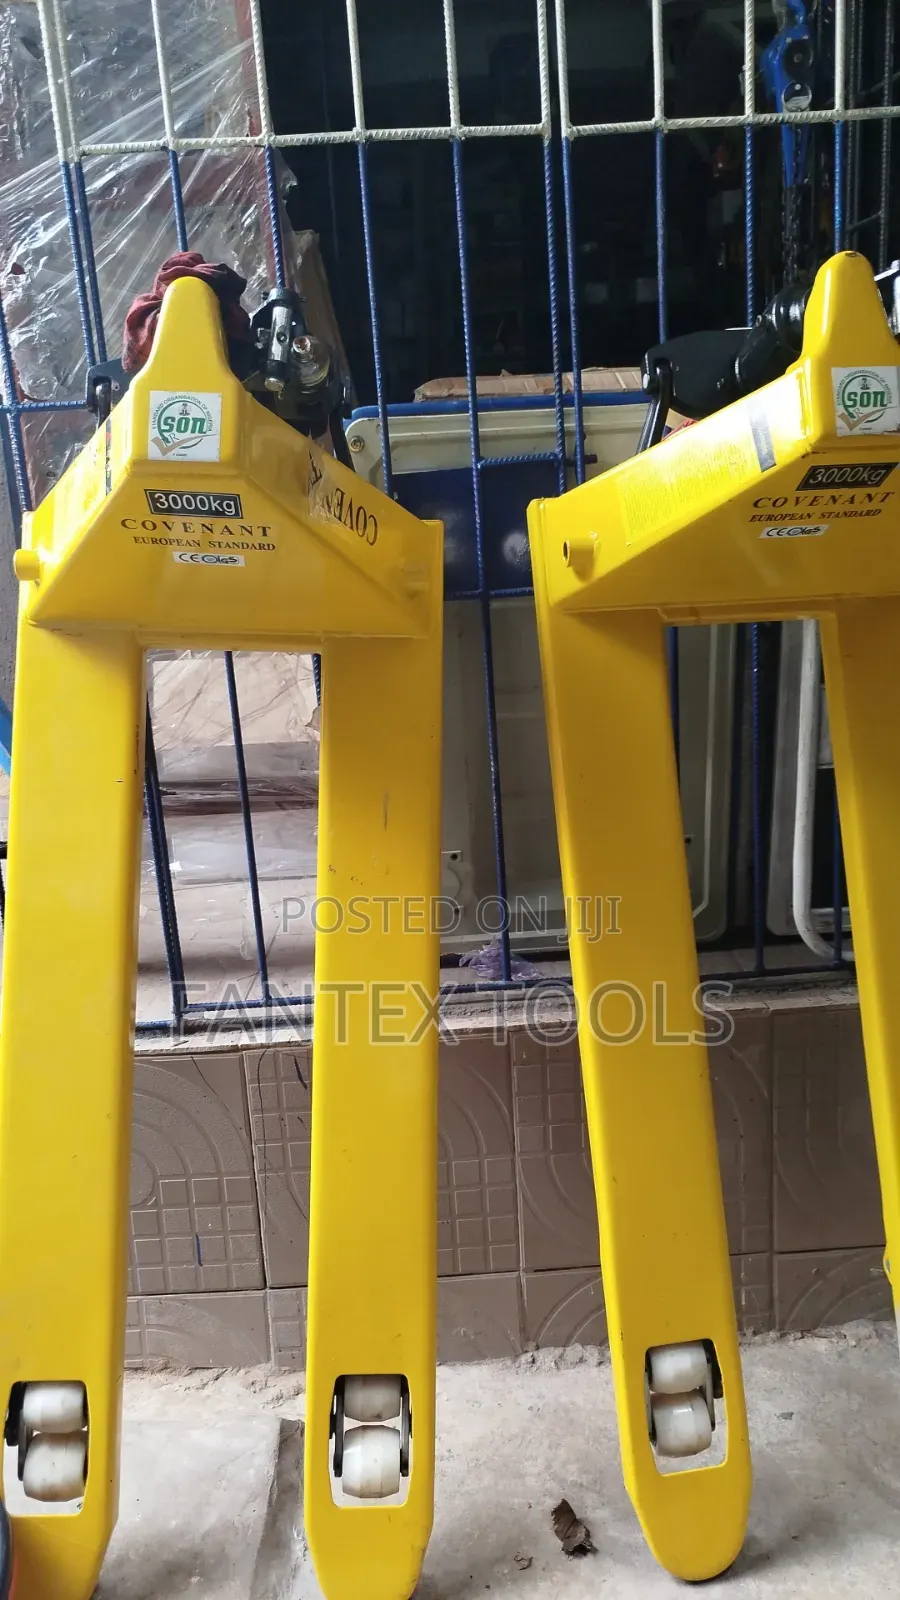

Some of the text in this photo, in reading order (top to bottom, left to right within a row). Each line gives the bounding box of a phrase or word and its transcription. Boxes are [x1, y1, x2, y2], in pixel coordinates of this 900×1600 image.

[809, 466, 888, 484] 3000kg
[154, 493, 236, 516] 3000kg
[752, 492, 895, 508] COVENANT
[748, 508, 882, 522] EUROPEAN STANDARD
[120, 518, 271, 537] COVENANT
[133, 536, 276, 551] EUROPEAN STANDARD
